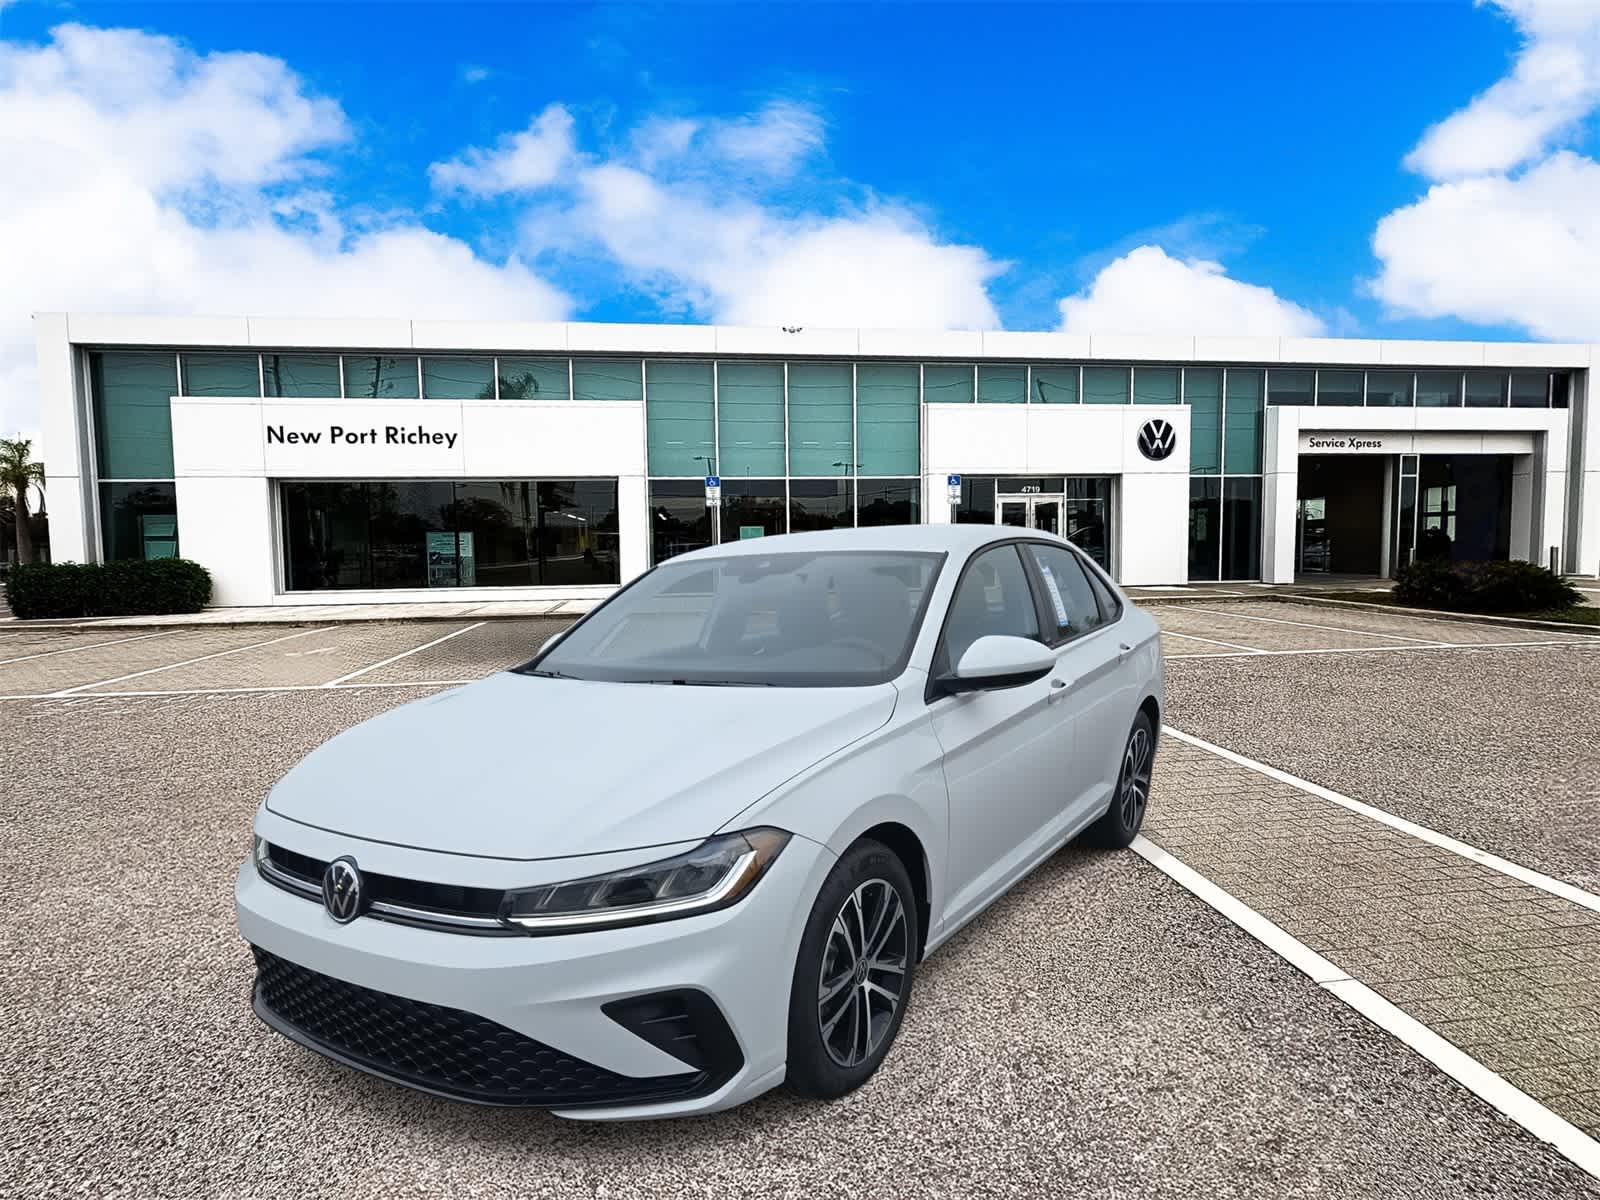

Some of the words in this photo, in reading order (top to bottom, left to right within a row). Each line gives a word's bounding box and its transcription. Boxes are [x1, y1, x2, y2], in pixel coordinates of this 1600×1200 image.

[266, 425, 322, 444] New
[330, 425, 378, 444] Port
[385, 425, 458, 448] Richey
[1138, 418, 1176, 459] VW
[1309, 437, 1345, 448] Service
[1348, 437, 1382, 450] Xpress
[1020, 485, 1041, 493] 4719
[324, 862, 359, 920] VW
